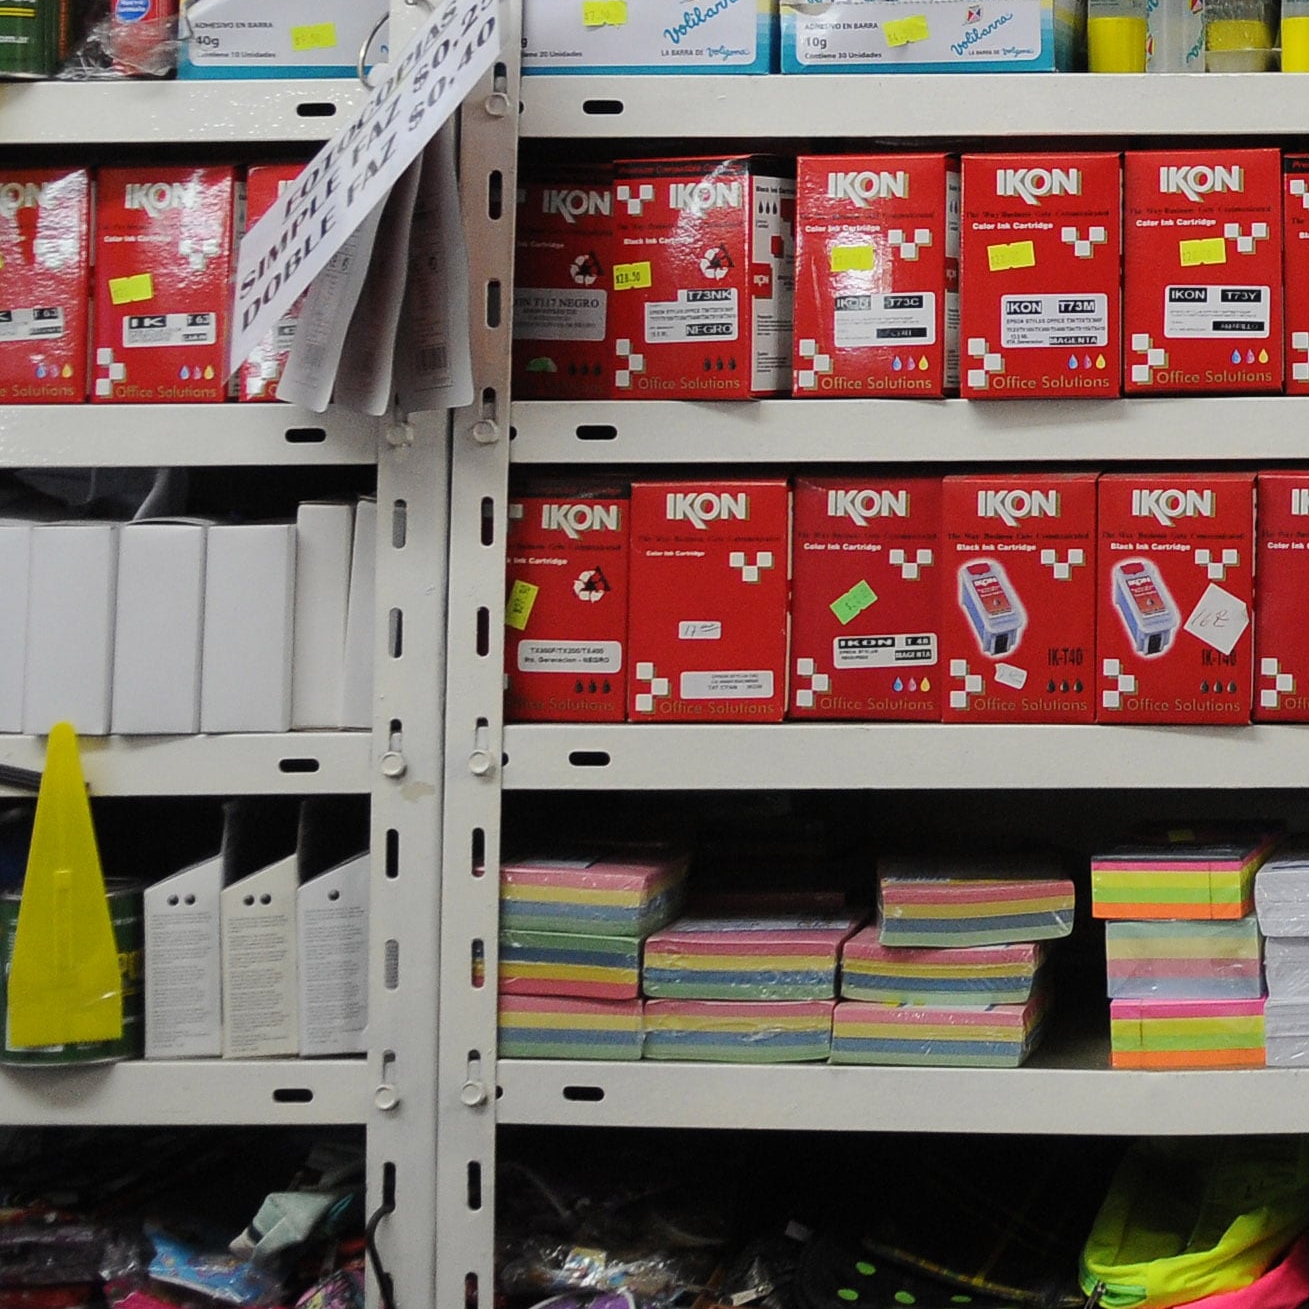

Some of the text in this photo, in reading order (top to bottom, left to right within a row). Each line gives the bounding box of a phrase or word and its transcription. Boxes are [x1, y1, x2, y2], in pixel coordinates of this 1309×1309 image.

[805, 36, 827, 49] 10g
[951, 13, 1013, 56] Volibarra
[848, 51, 882, 59] Unidades
[241, 15, 496, 333] DOBLE FAZ $0.40
[828, 171, 909, 208] IKON
[996, 168, 1081, 206] IKON
[1159, 165, 1244, 203] IKON
[239, 173, 341, 301] SIMPLE
[352, 95, 402, 166] FAZ
[669, 181, 742, 218] IKON
[972, 222, 995, 230] Color
[1013, 222, 1053, 230] Cartridge
[687, 290, 732, 302] T73NK
[1006, 300, 1096, 314] IKON T73M
[686, 323, 733, 337] NEGRO
[1049, 336, 1098, 345] MAGENTA
[992, 374, 1110, 390] Office Solutions
[541, 504, 621, 540] IKON
[666, 492, 750, 530] IKON
[827, 490, 910, 527] IKON
[977, 490, 1061, 528] IKON
[1132, 489, 1216, 526] IKON
[1048, 648, 1083, 667] IK-T40
